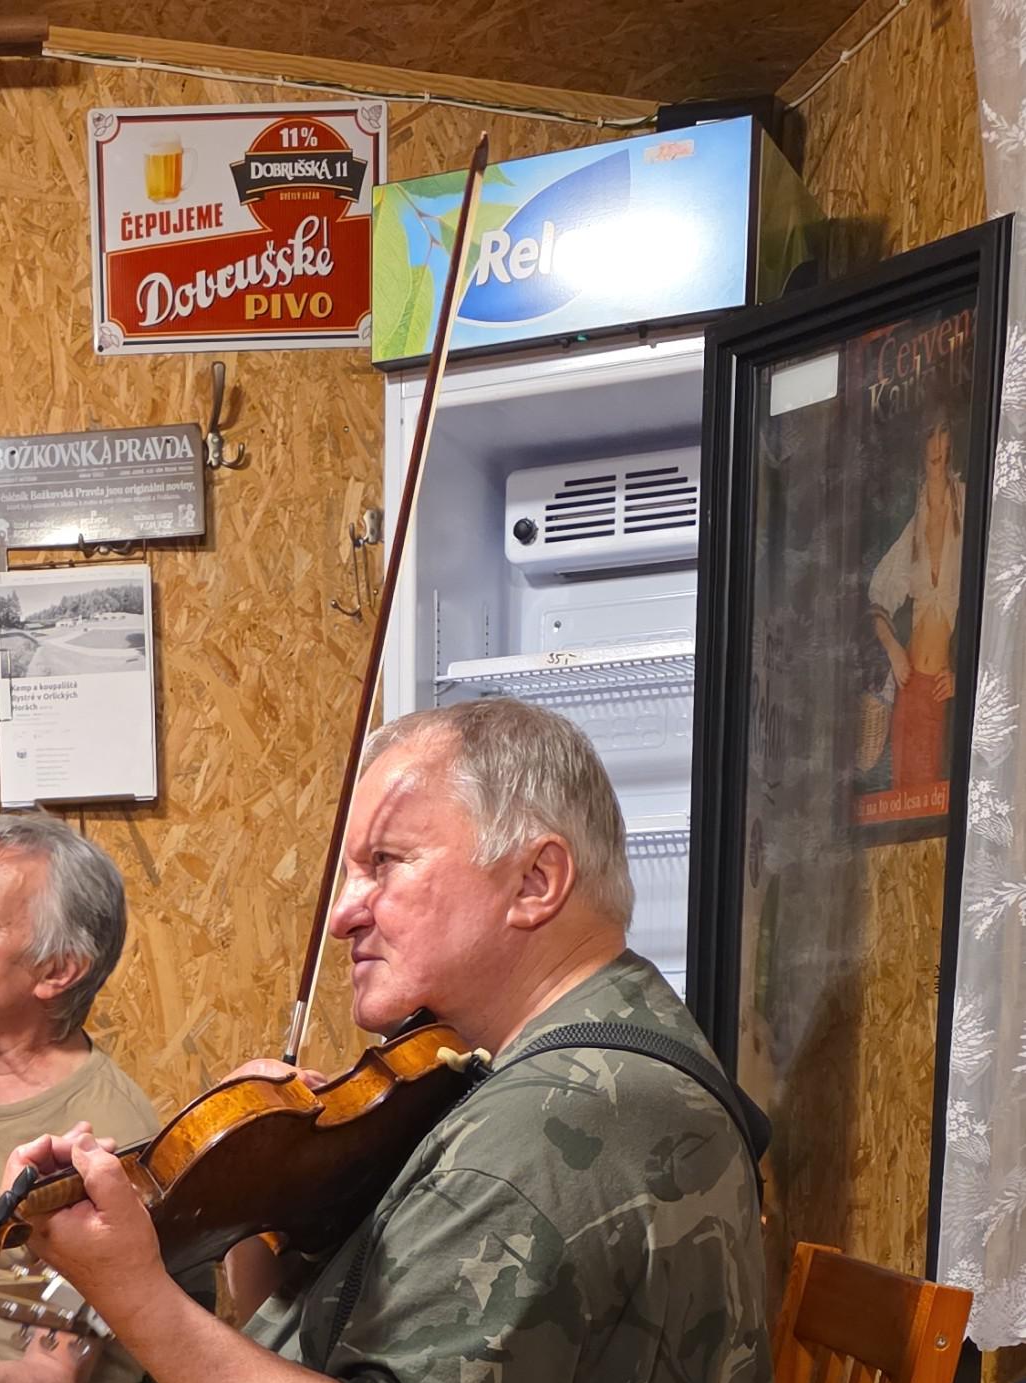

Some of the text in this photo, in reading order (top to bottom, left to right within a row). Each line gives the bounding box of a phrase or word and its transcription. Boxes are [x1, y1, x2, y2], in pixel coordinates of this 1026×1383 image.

[279, 127, 318, 147] 11%
[250, 158, 348, 181] DOBRUŠSKÁ 11
[120, 202, 223, 242] ČEPUJEME
[136, 215, 334, 326] Dobrušské
[244, 291, 333, 320] PIVO
[114, 433, 194, 463] PRAVDA
